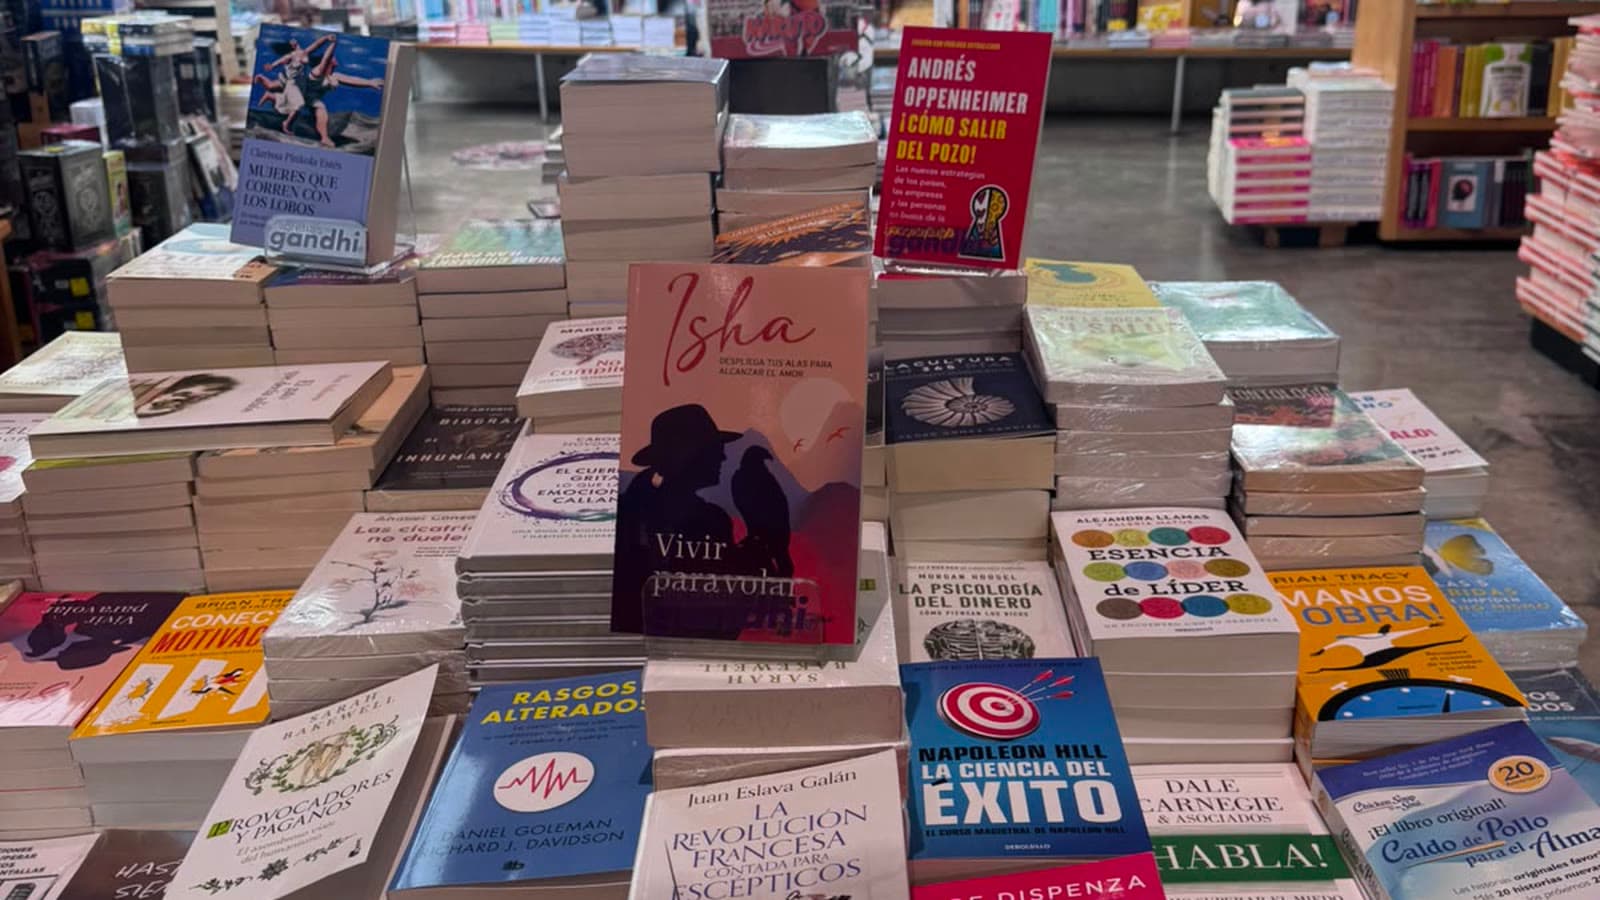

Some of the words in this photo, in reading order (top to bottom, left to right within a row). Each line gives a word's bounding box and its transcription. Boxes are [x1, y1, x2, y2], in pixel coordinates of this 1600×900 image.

[907, 54, 977, 82] ANDRÉS
[903, 86, 1029, 115] OPPENHEIMER
[899, 110, 955, 136] ¡CÓMO
[959, 118, 1007, 140] SALIR
[250, 148, 283, 161] Clarissa
[285, 152, 318, 167] Pinkola
[896, 140, 925, 161] DEL
[929, 142, 977, 164] POZO!
[248, 163, 306, 183] MUJERES
[307, 173, 338, 190] QUE
[940, 168, 986, 181] estrategias
[245, 178, 299, 199] CORREN
[302, 188, 332, 204] CON
[243, 193, 269, 209] LOS
[270, 197, 316, 216] LOBOS
[270, 228, 360, 253] gandhi
[560, 326, 613, 334] MARIO
[662, 272, 817, 387] Isha
[595, 359, 622, 367] No
[719, 356, 766, 367] DESPLIEGA
[767, 358, 783, 368] TUS
[785, 359, 809, 369] ALAS
[809, 360, 833, 369] PARA
[719, 367, 764, 377] ALCANZAR
[766, 368, 777, 377] EL
[779, 369, 805, 378] AMOR
[555, 468, 572, 476] EL
[353, 525, 392, 535] Las
[1076, 514, 1154, 524] ALEJANDRA
[1155, 513, 1210, 522] LLAMAS
[367, 534, 396, 543] no
[655, 532, 728, 561] Vivir
[1089, 546, 1231, 562] ESENCIA
[652, 571, 720, 598] para
[723, 567, 799, 598] volar
[917, 573, 966, 581] MORGAN
[1103, 584, 1140, 597] de
[1148, 577, 1250, 596] LÍDER
[1334, 570, 1413, 582] TRACY
[899, 583, 923, 596] LA
[930, 582, 1043, 597] PSICOLOGÍA
[1281, 585, 1433, 608] MANOS
[41, 604, 95, 618] volar
[98, 603, 149, 614] para
[195, 599, 252, 609] BRIAN
[914, 596, 952, 608] DEL
[960, 596, 1033, 610] DINERO
[1302, 602, 1446, 627] OBRA!
[83, 615, 135, 626] Vivir
[171, 610, 282, 630] CONEC
[149, 625, 269, 654] MOTIVAC
[702, 660, 848, 673] BAKEWELL
[726, 673, 820, 685] SARAH
[512, 680, 638, 705] RASGOS
[281, 697, 396, 741] BAKEWELL
[309, 691, 380, 724] SARAH
[919, 744, 1046, 763] NAPOLEON
[1055, 744, 1108, 760] HILL
[921, 762, 952, 780] LA
[959, 761, 1060, 779] CIENCIA
[1066, 760, 1111, 777] DEL
[1499, 760, 1535, 783] 20
[688, 791, 730, 808] Juan
[737, 779, 795, 800] Eslava
[800, 768, 858, 789] Galán
[1165, 779, 1241, 794] DALE
[206, 768, 395, 840] PROVOCADORES
[754, 801, 789, 822] LA
[922, 778, 1123, 826] ÉXITO
[1140, 797, 1284, 813] CARNEGIE
[1352, 799, 1393, 813] Chicken
[236, 830, 250, 844] Y
[253, 796, 355, 840] PAGANOS
[443, 826, 507, 842] DANIEL
[514, 818, 613, 837] GOLEMAN
[672, 805, 868, 851] REVOLUCIÓN
[1157, 815, 1171, 825] &
[1175, 813, 1274, 824] ASOCIADOS
[1367, 824, 1391, 841] ¡El
[1396, 817, 1434, 835] libro
[1435, 798, 1508, 824] original!
[503, 840, 518, 854] J.
[526, 830, 625, 851] DAVIDSON
[692, 830, 847, 869] FRANCESA
[1382, 840, 1457, 865] Caldo
[1462, 835, 1484, 849] de
[1477, 814, 1549, 843] Pollo
[1464, 847, 1508, 868] para
[1507, 840, 1528, 856] el
[1528, 826, 1600, 860] Alma
[703, 859, 788, 881] CONTADA
[792, 852, 830, 868] PARA
[1153, 842, 1329, 871] HABLA!
[995, 875, 1148, 900] DISPENZA
[1451, 886, 1471, 896] Las
[1470, 876, 1513, 892] historias
[1513, 861, 1569, 882] originales
[1495, 888, 1512, 899] 20
[1511, 874, 1563, 894] historias
